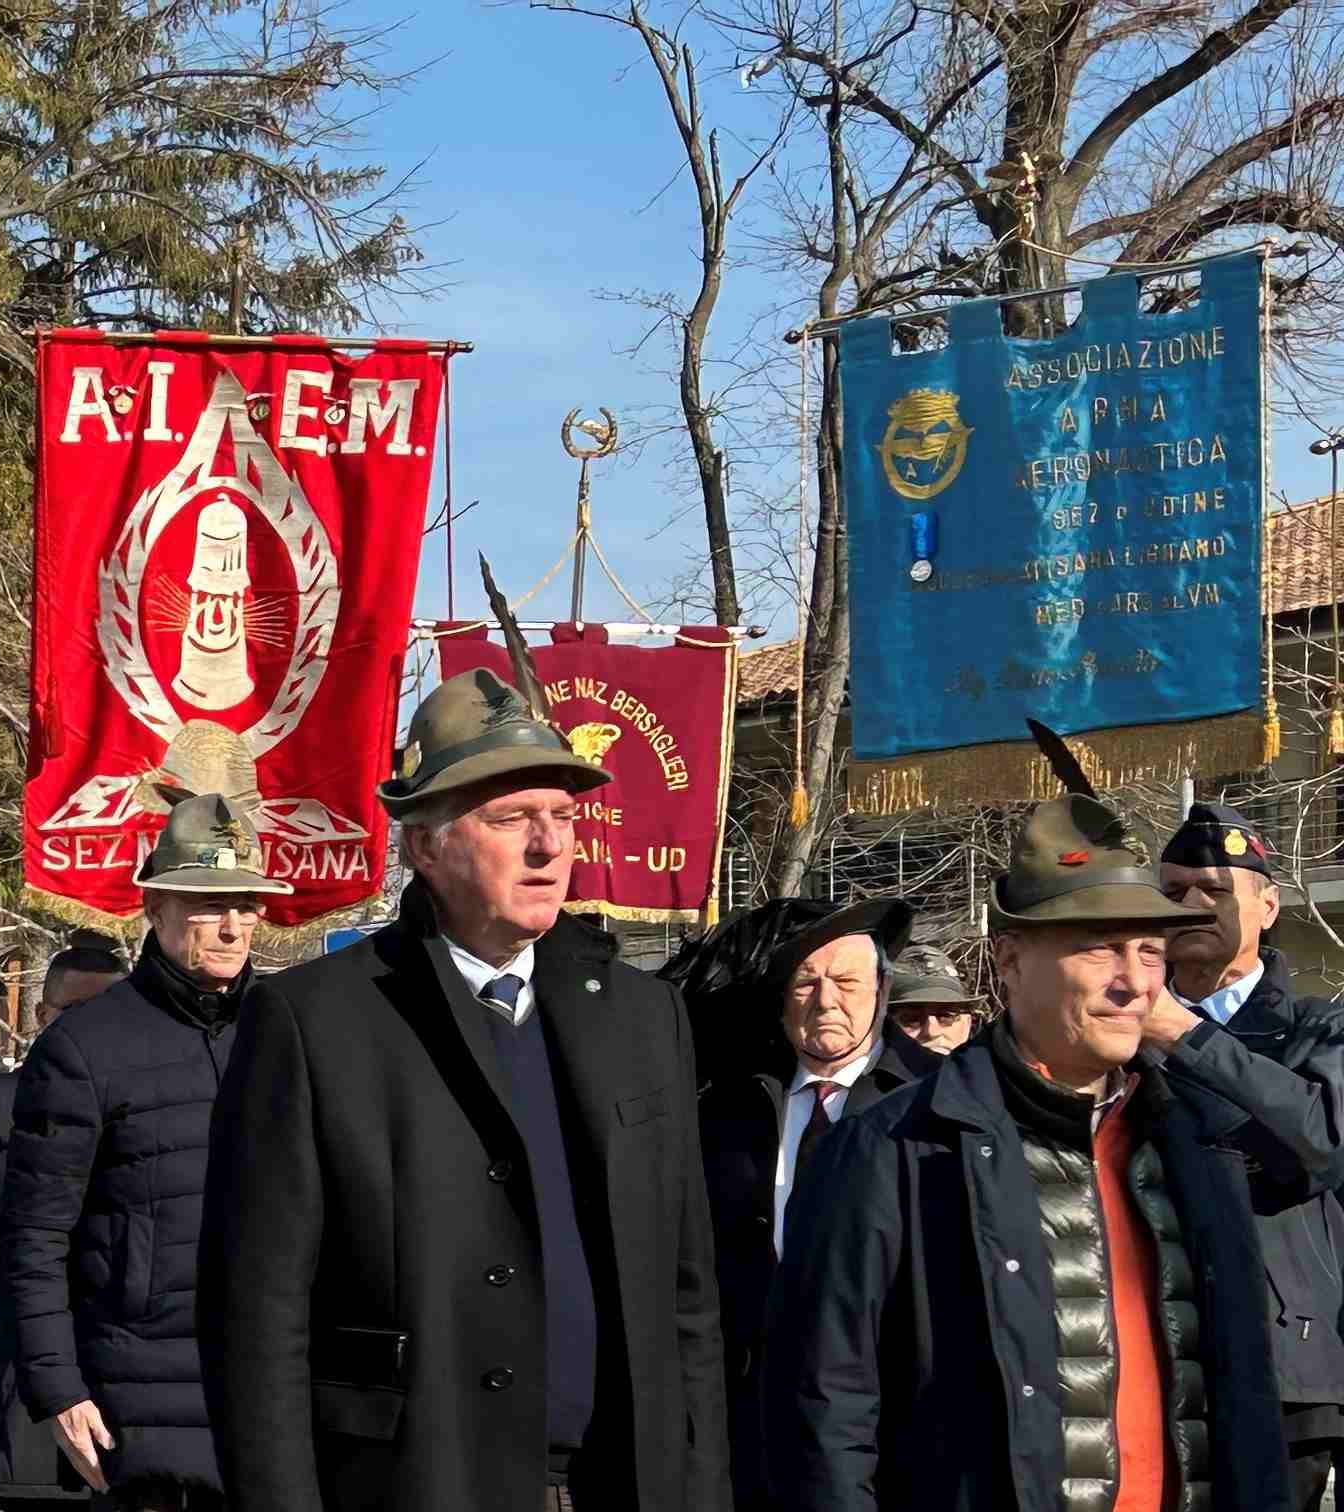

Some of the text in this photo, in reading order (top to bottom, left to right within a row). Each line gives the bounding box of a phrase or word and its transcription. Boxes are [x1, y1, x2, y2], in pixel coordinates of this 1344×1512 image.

[1007, 326, 1225, 391] ASSOCIAZIONE
[610, 689, 689, 791] BERSAGLIERI
[647, 846, 687, 872] UD
